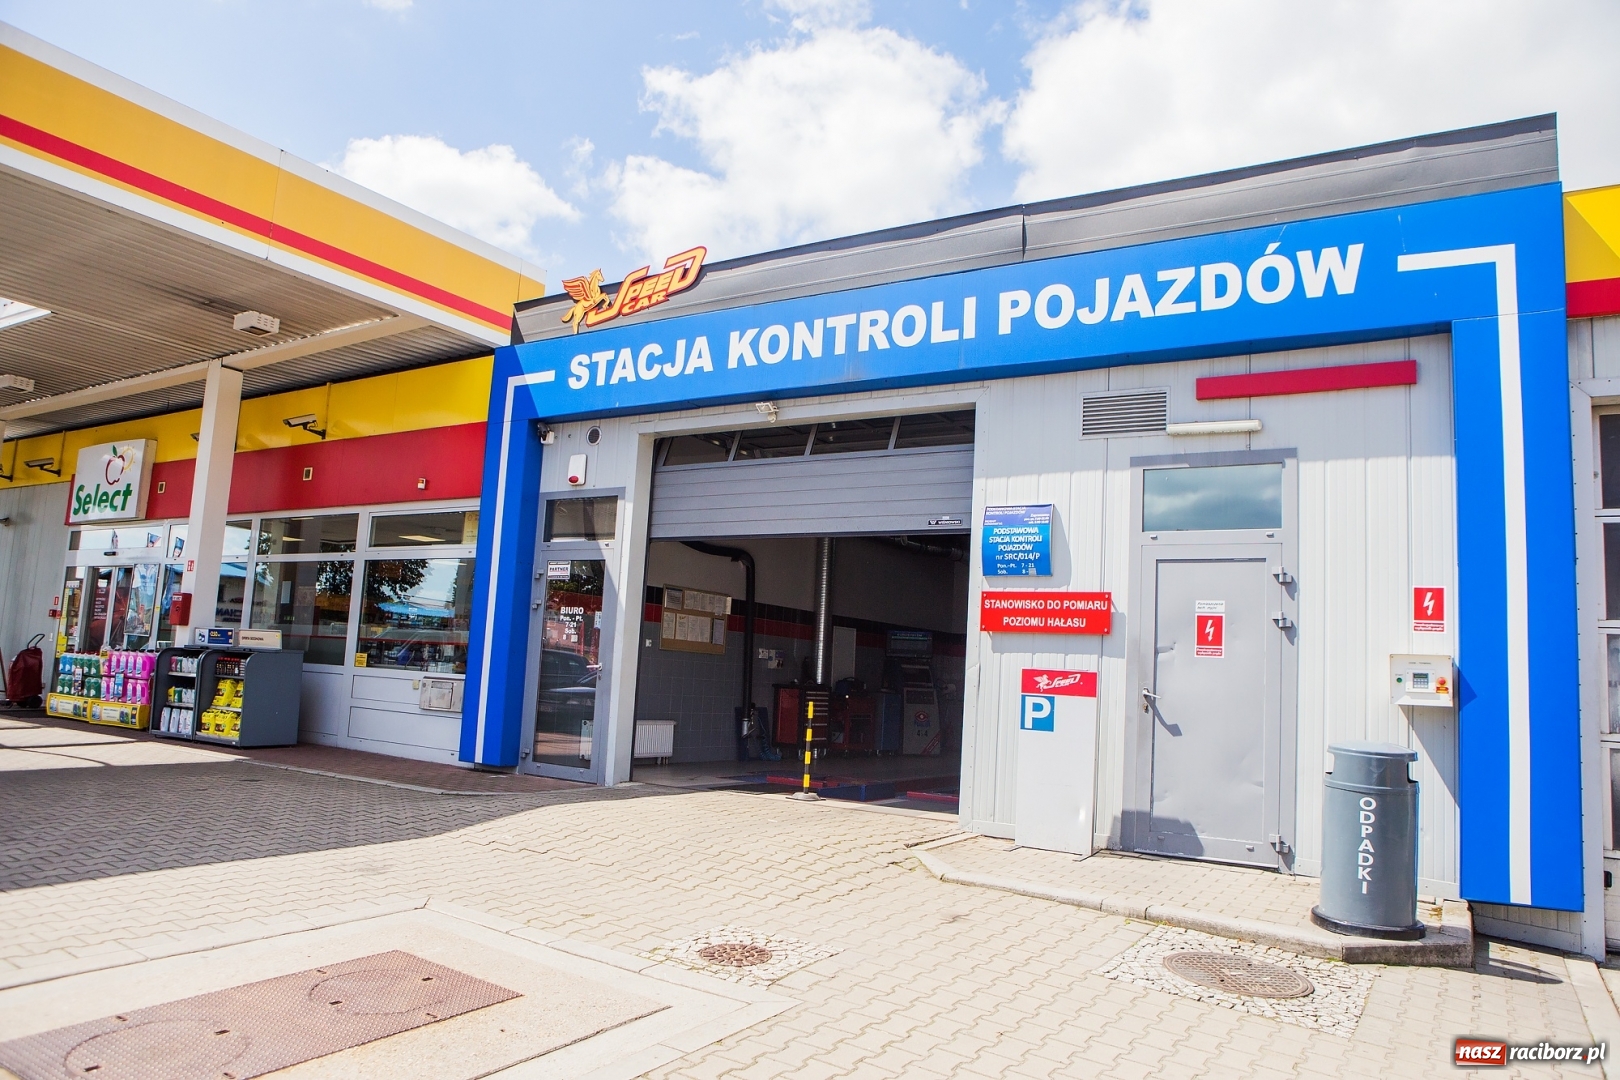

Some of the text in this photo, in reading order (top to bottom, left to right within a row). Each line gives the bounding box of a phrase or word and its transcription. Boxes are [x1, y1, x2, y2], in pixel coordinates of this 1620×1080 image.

[585, 246, 707, 327] SPEED
[620, 290, 669, 316] CAR
[567, 242, 1365, 390] STACJA KONTROLI POJAZDÓW
[73, 483, 133, 516] Select
[993, 526, 1039, 535] PODSTAWOWA
[1011, 535, 1043, 543] KONTROLI
[998, 543, 1033, 551] POJAZDÓW
[1004, 552, 1041, 561] SRC/014/P
[984, 599, 1108, 610] STANOWISKO DO POMIARU
[560, 606, 584, 615] BIURO
[1003, 617, 1087, 628] POZIOMU HAŁASU
[1024, 696, 1052, 729] P
[1358, 796, 1377, 895] ODPADKI
